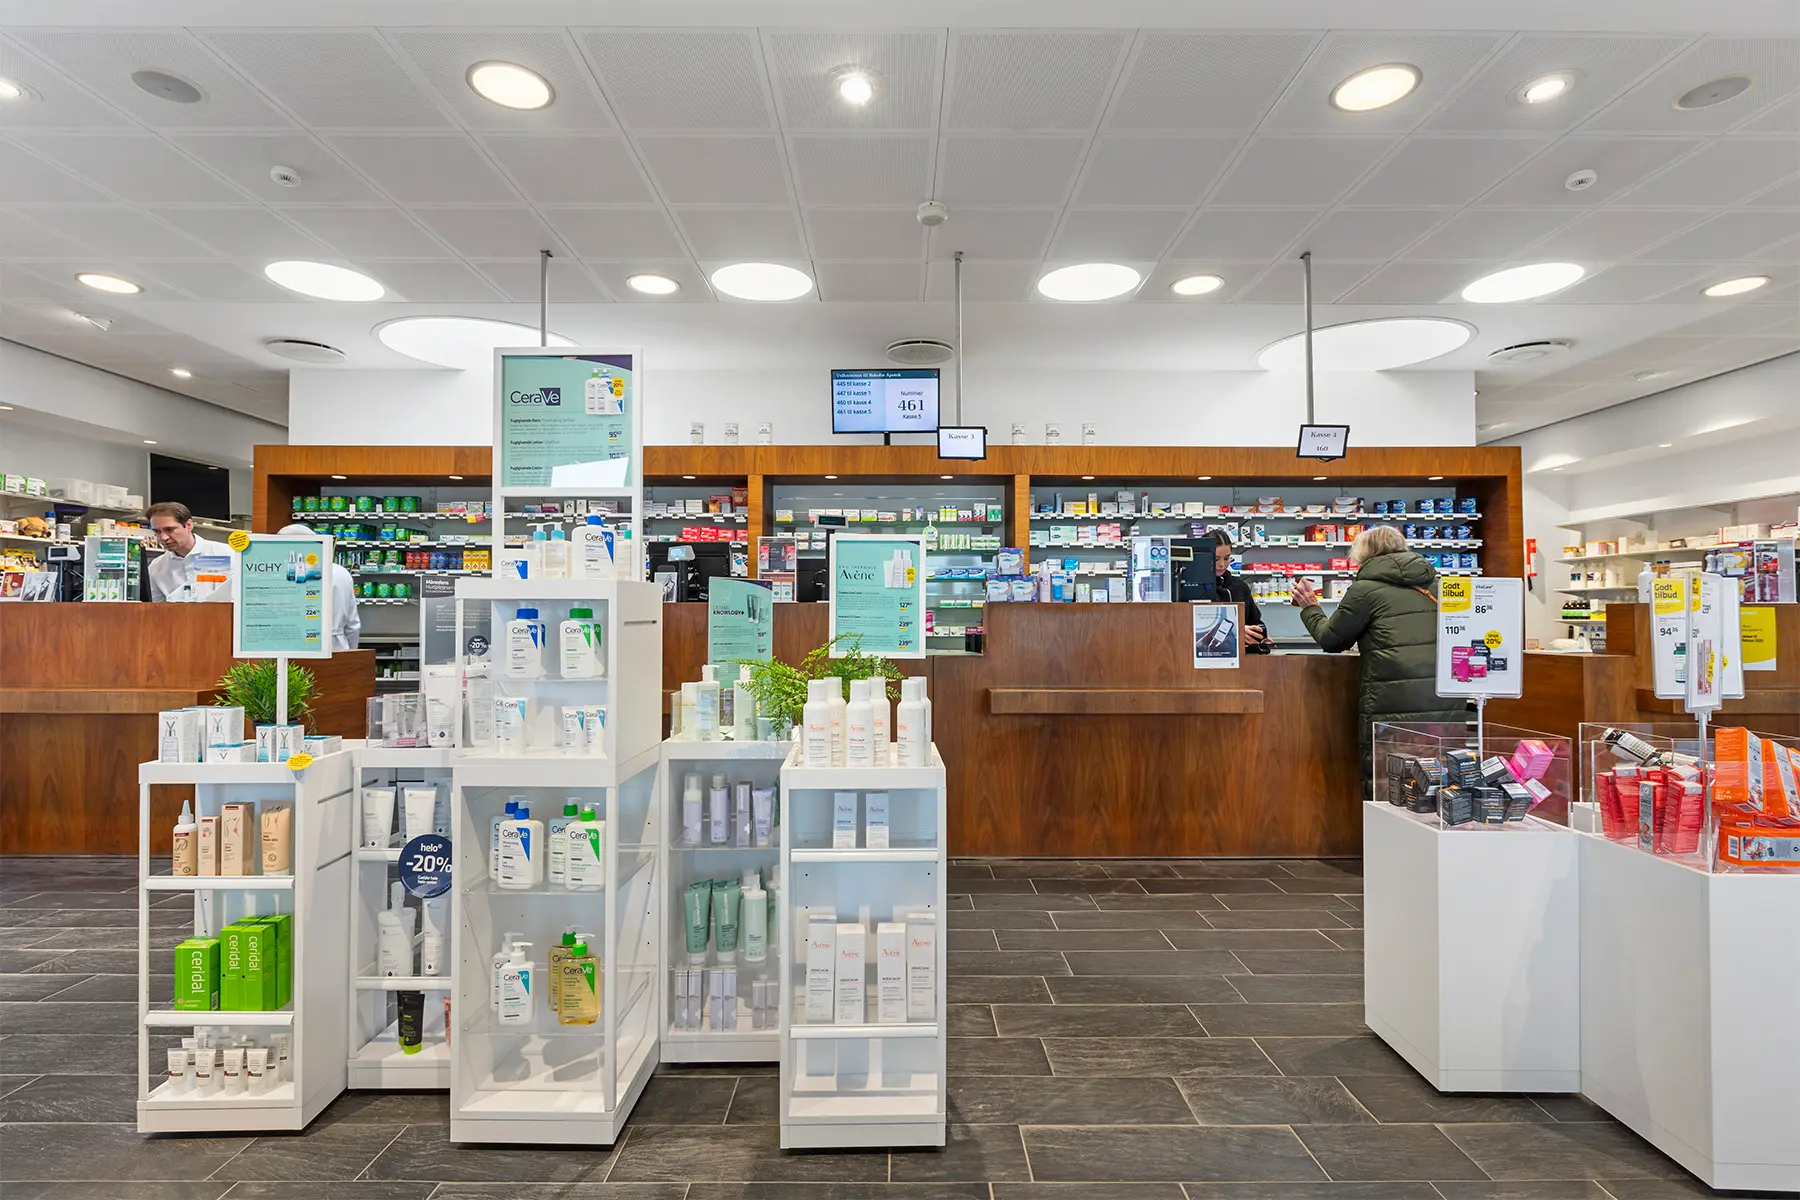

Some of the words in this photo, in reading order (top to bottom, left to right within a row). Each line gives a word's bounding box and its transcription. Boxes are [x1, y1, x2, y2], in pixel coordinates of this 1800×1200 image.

[510, 389, 560, 405] CeraVe
[898, 400, 924, 411] 461
[585, 533, 612, 542] CeraVe
[246, 563, 282, 572] VICHY
[840, 569, 875, 580] Avène
[503, 829, 528, 838] CeraVe
[570, 830, 597, 839] CeraVe
[406, 855, 452, 873] -20%
[229, 935, 240, 970] ceridal
[249, 936, 260, 971] ceridal
[192, 951, 206, 994] ceridal
[563, 966, 592, 975] CeraVe
